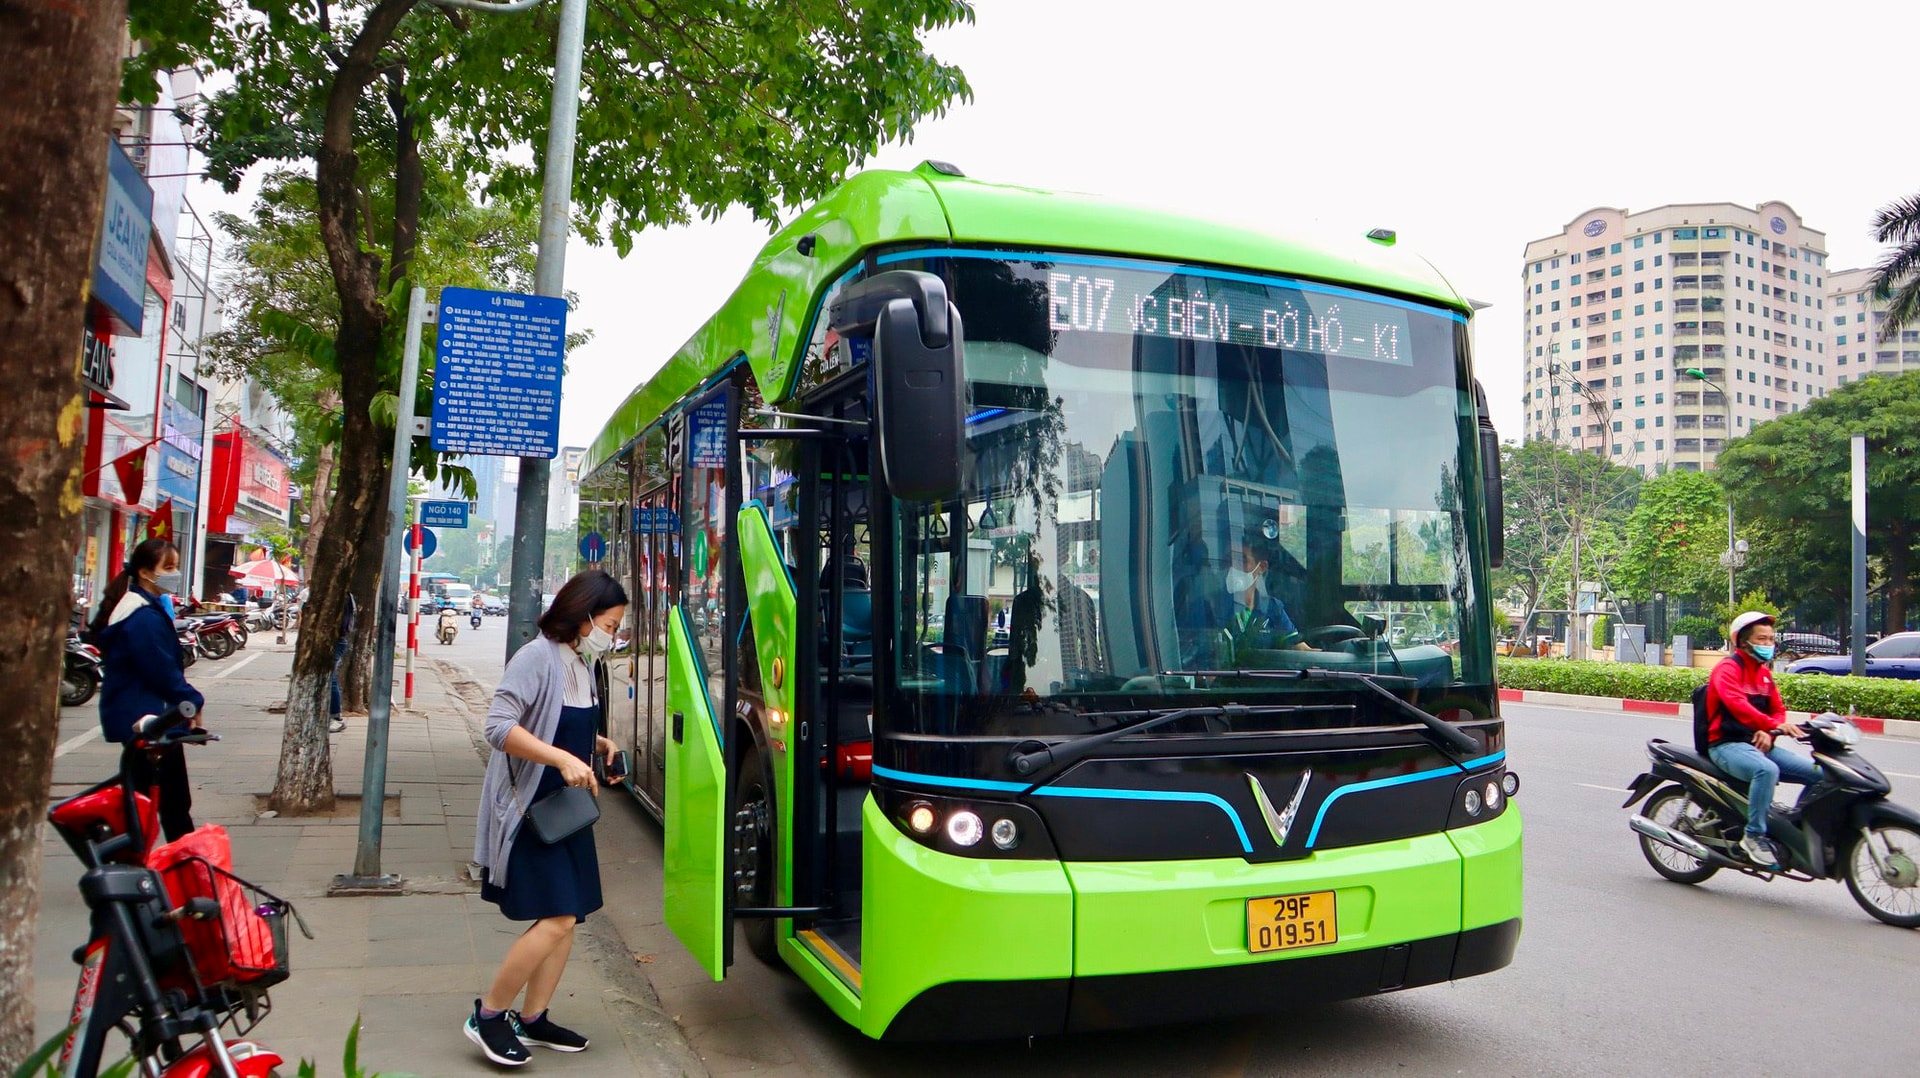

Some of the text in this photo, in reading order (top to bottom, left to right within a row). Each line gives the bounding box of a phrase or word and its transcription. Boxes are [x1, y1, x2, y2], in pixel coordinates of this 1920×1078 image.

[109, 200, 145, 266] JEANS
[1050, 272, 1114, 332] E07
[1168, 290, 1229, 341] BIÊN
[1264, 301, 1299, 348] BỜ
[448, 506, 461, 515] 140
[1274, 896, 1310, 921] 29F
[1260, 920, 1325, 948] 019.51
